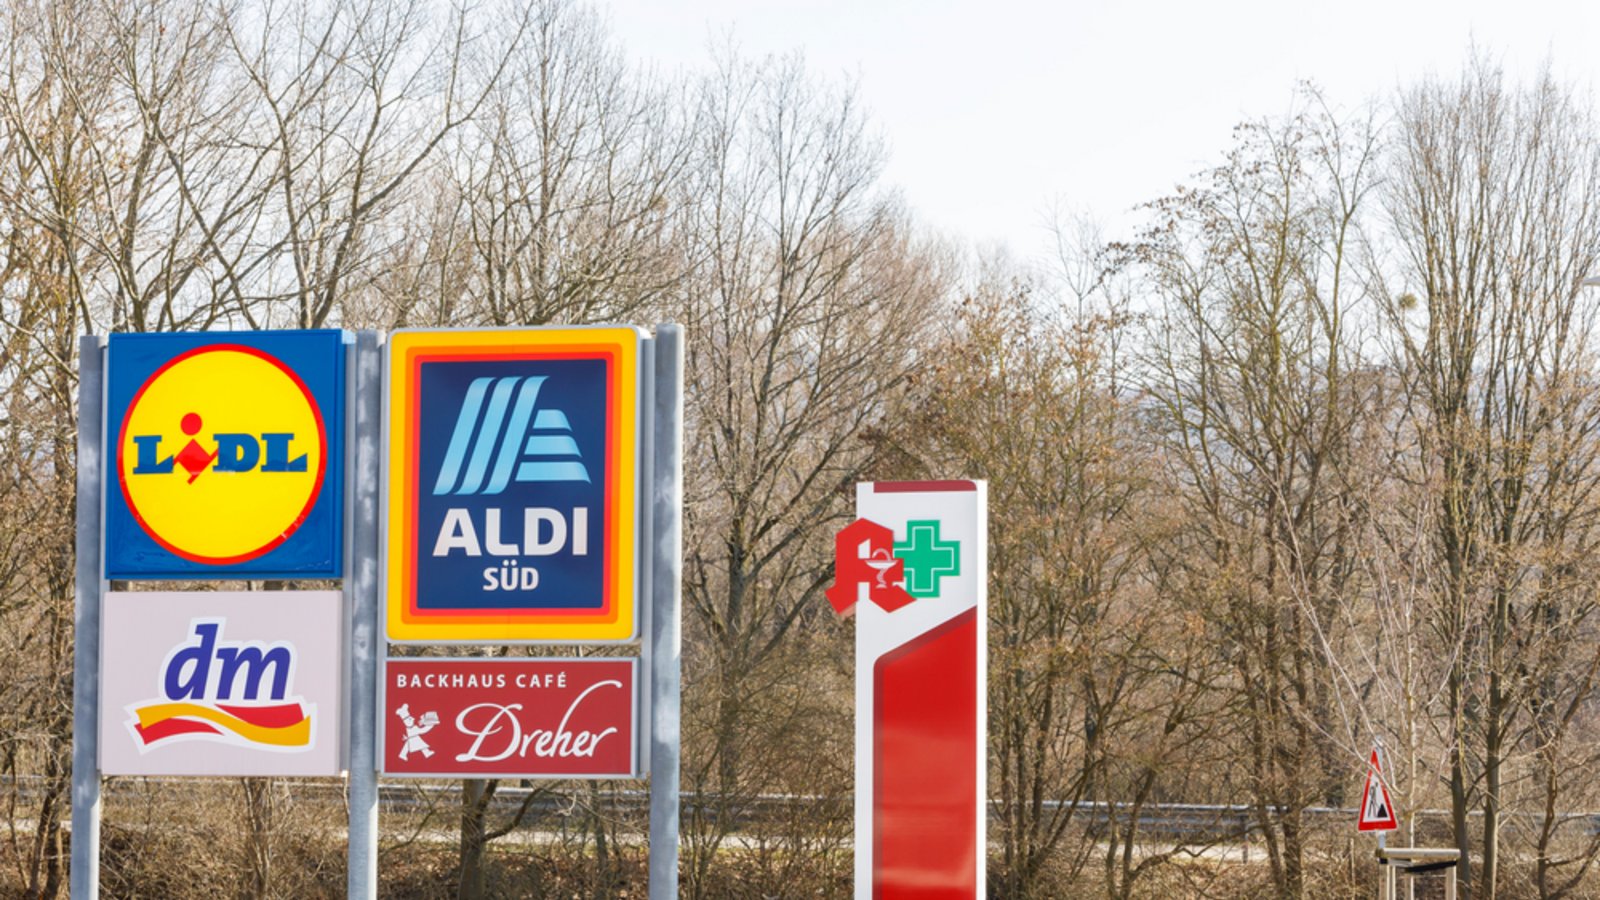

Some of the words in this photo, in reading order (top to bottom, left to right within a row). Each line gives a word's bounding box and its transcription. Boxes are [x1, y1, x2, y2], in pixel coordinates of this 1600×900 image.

[432, 507, 588, 557] ALDI
[482, 559, 539, 590] SÜD
[164, 623, 291, 701] dm
[396, 674, 506, 688] BACKHAUS
[515, 671, 567, 688] CAFÉ
[455, 680, 623, 762] Dreher
